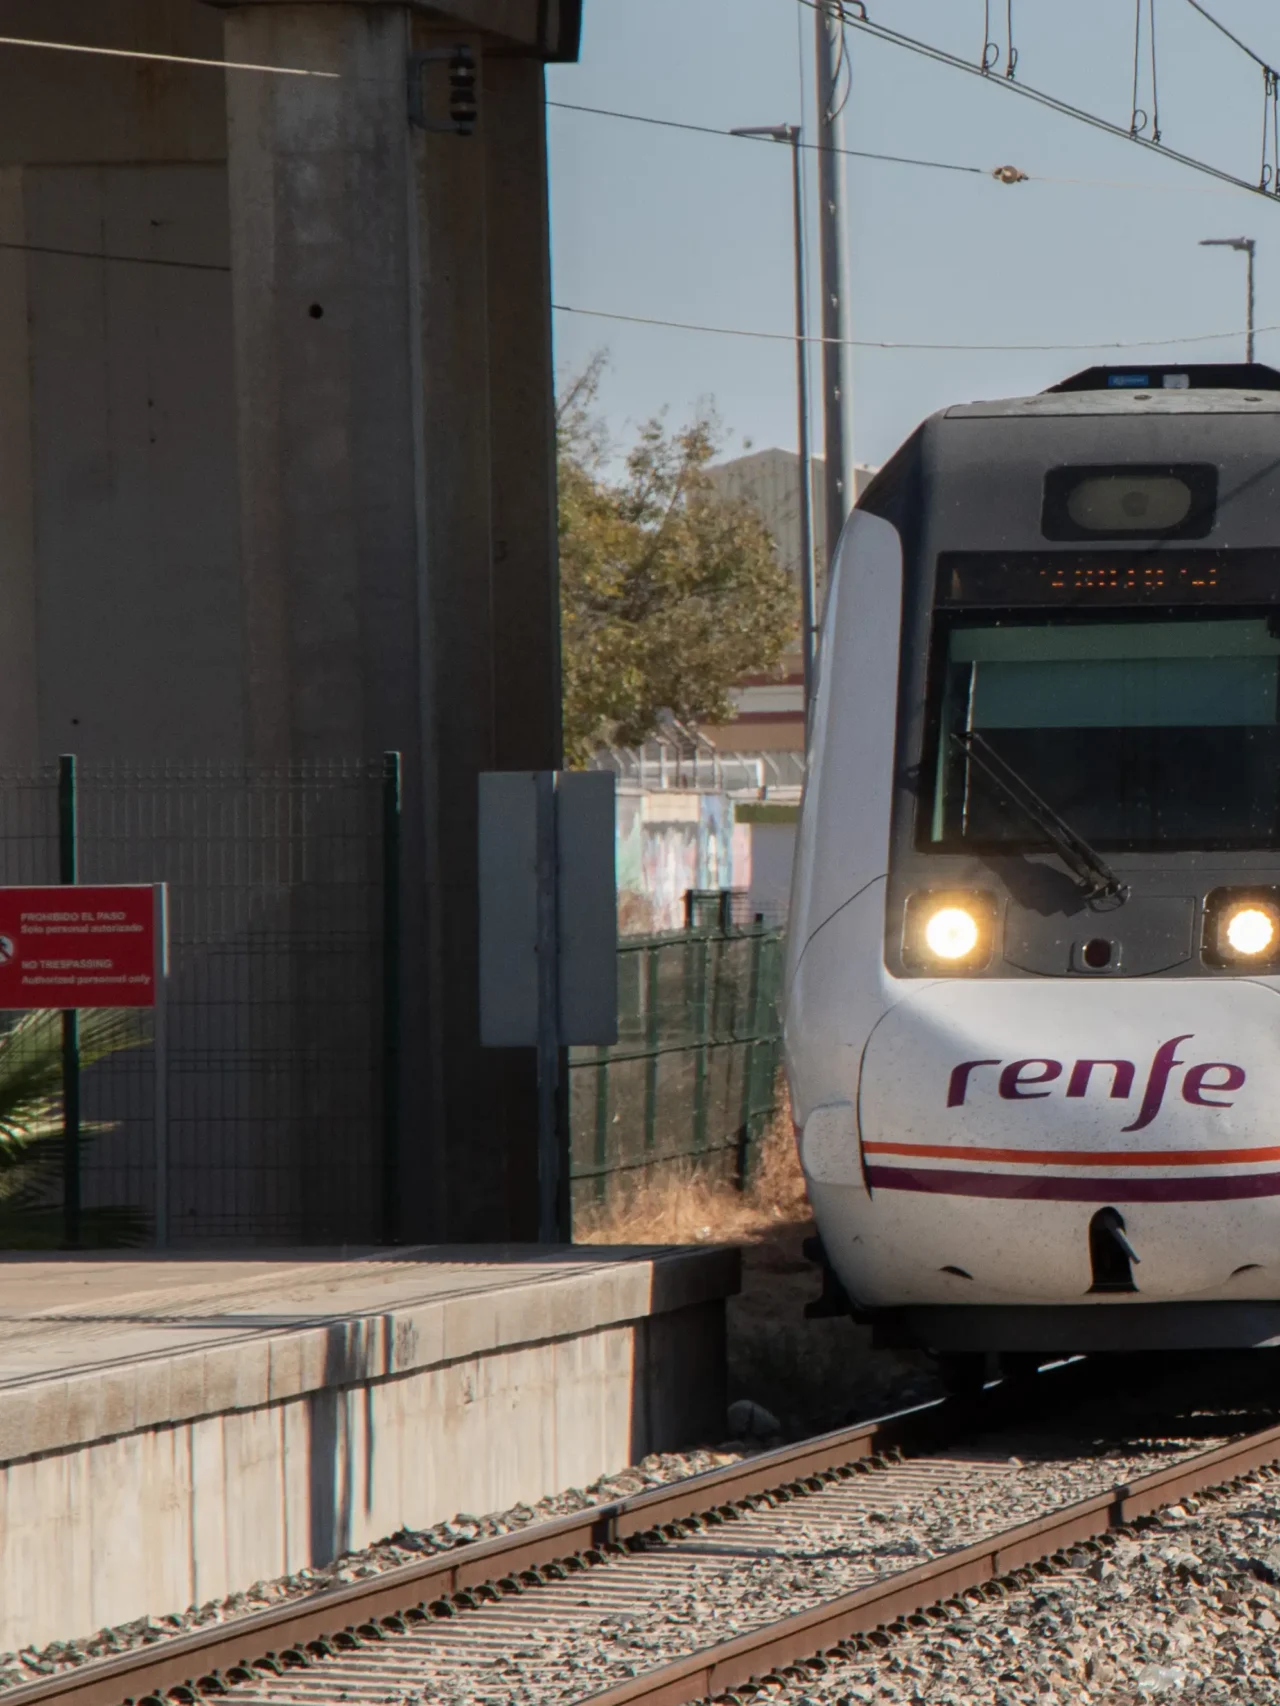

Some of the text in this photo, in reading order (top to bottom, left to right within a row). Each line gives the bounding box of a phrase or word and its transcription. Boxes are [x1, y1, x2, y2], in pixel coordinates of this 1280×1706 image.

[21, 911, 126, 922] PROHIBIDO EL PASO
[46, 925, 89, 935] personal
[91, 924, 143, 933] autorizado
[22, 959, 113, 969] NO TRESPASSING
[77, 974, 126, 986] personnel
[128, 973, 151, 985] only
[946, 1033, 1246, 1132] renfe
